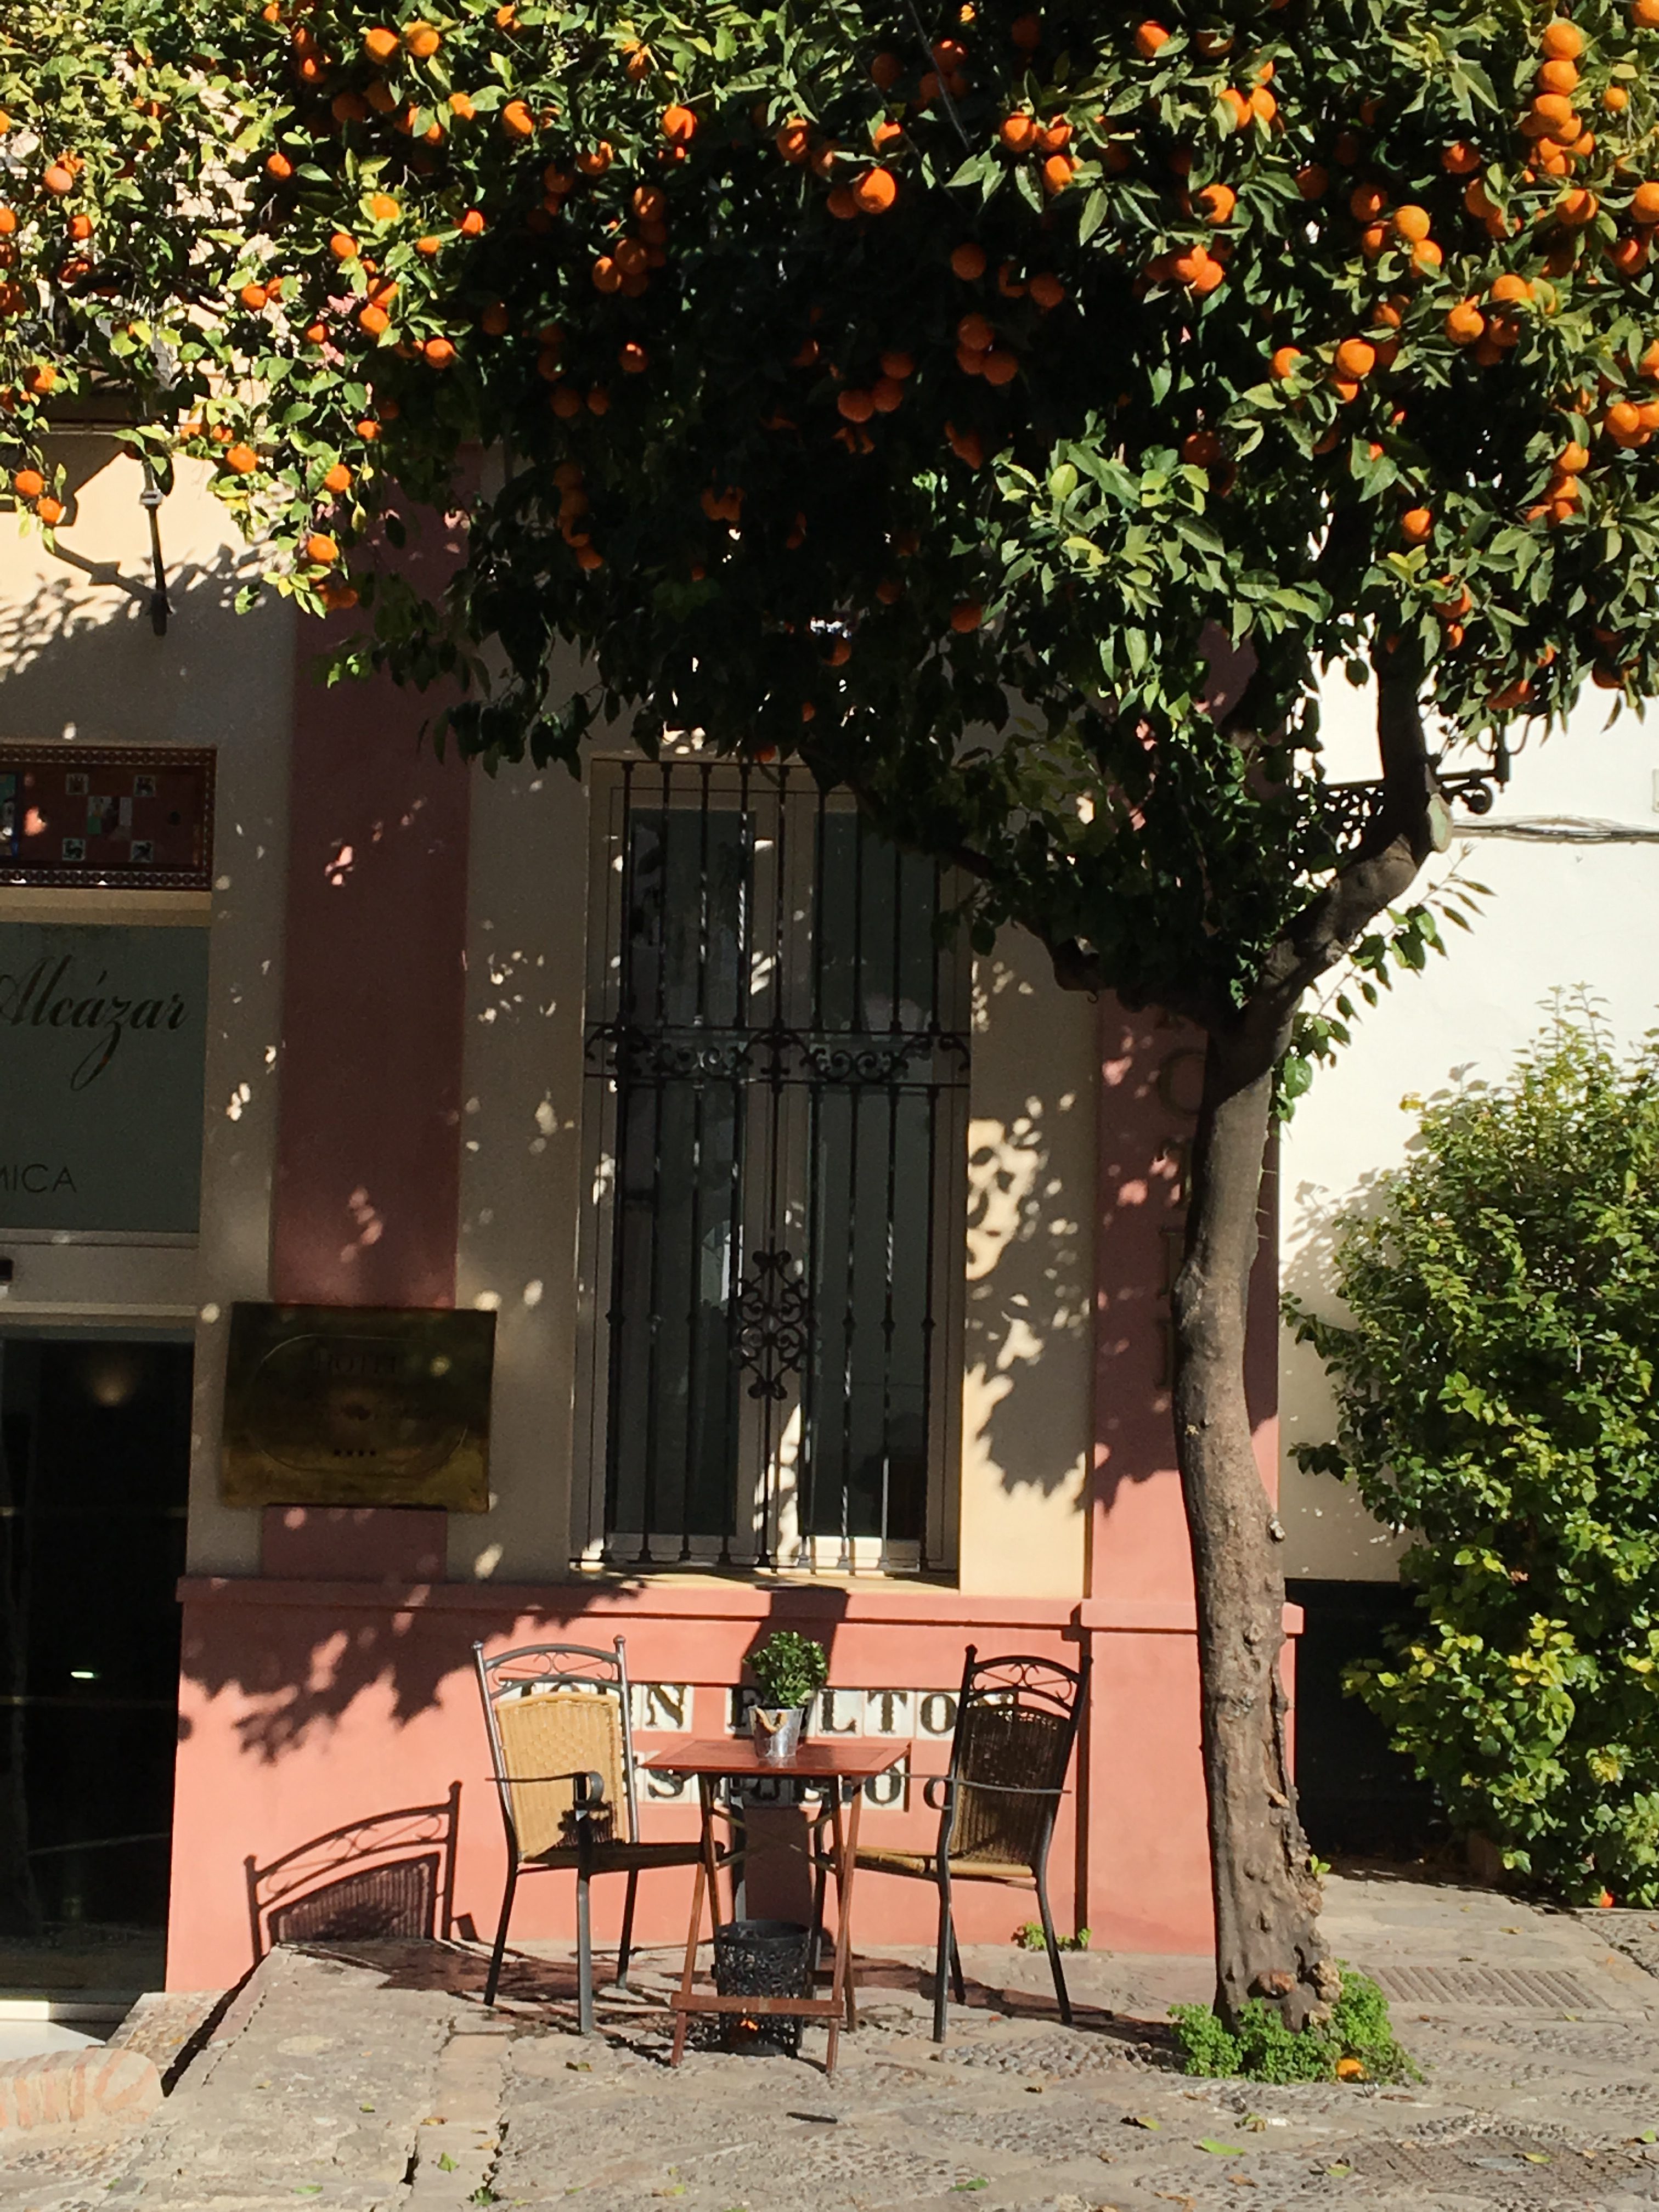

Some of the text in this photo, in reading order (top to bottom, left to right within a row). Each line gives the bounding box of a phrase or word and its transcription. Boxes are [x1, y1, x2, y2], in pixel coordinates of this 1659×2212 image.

[0, 954, 188, 1091] Alcázar
[0, 1164, 77, 1193] ICA
[727, 1685, 1013, 1735] FLTO
